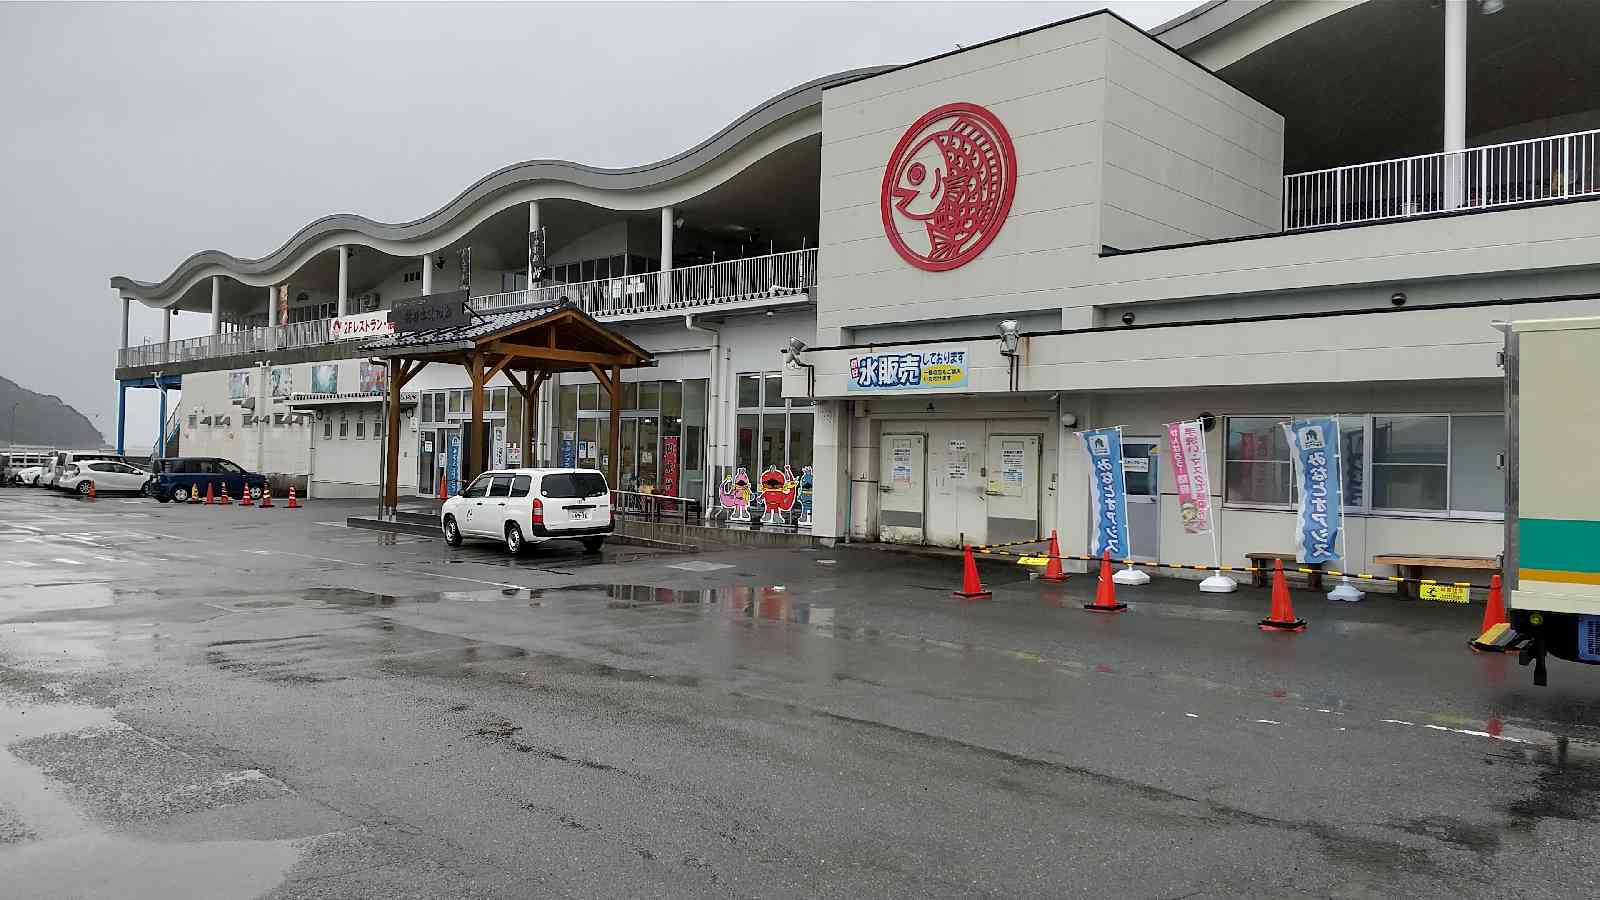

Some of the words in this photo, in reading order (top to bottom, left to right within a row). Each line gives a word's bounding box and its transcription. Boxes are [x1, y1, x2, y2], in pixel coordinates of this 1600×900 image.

[858, 353, 920, 387] 氷販売
[922, 351, 966, 366] しております
